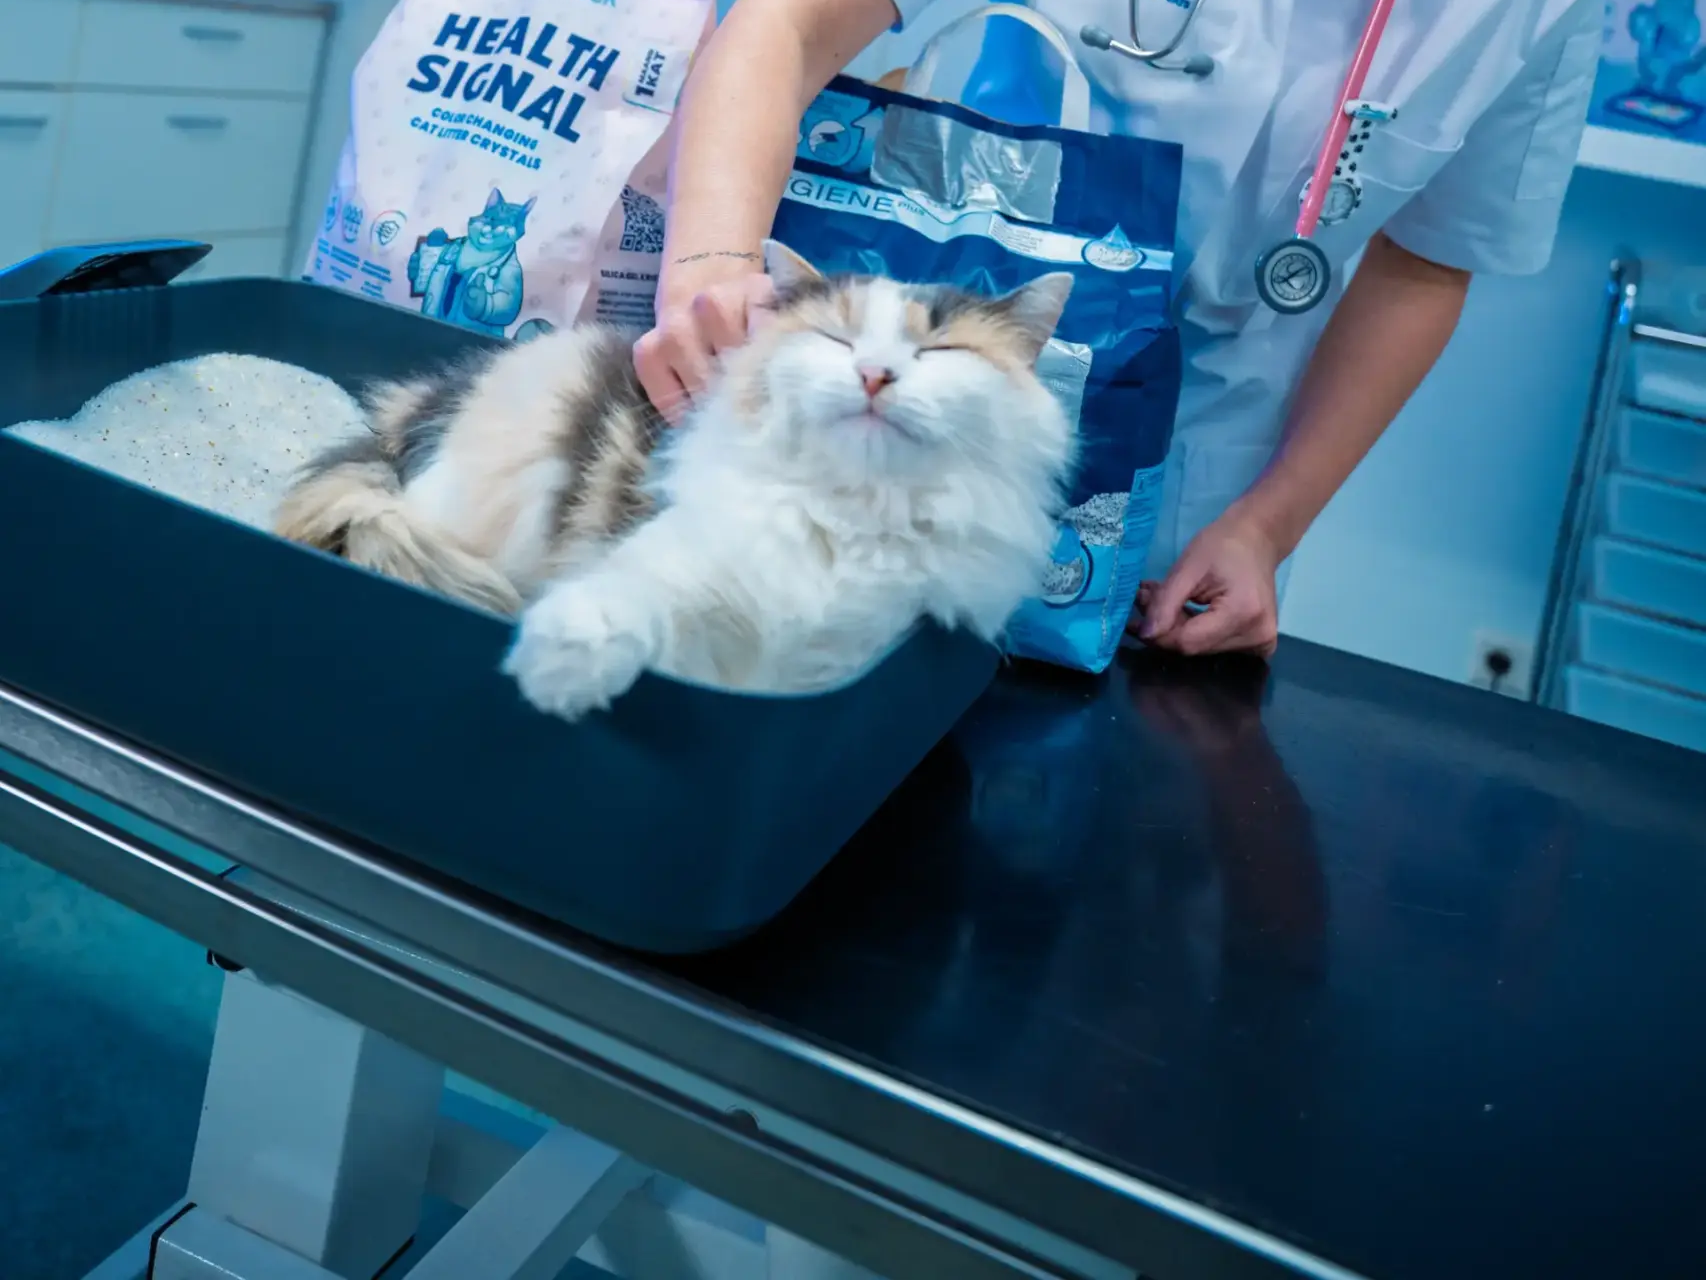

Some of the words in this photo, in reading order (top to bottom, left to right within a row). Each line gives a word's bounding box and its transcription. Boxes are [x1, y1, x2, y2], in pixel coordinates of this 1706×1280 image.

[433, 12, 620, 92] HEALTH
[646, 50, 666, 87] KAT
[406, 53, 586, 144] SIGNAL
[635, 85, 655, 98] 1
[409, 116, 439, 135] CAT
[469, 133, 543, 170] CRYSTALS
[789, 176, 893, 214] GIENE
